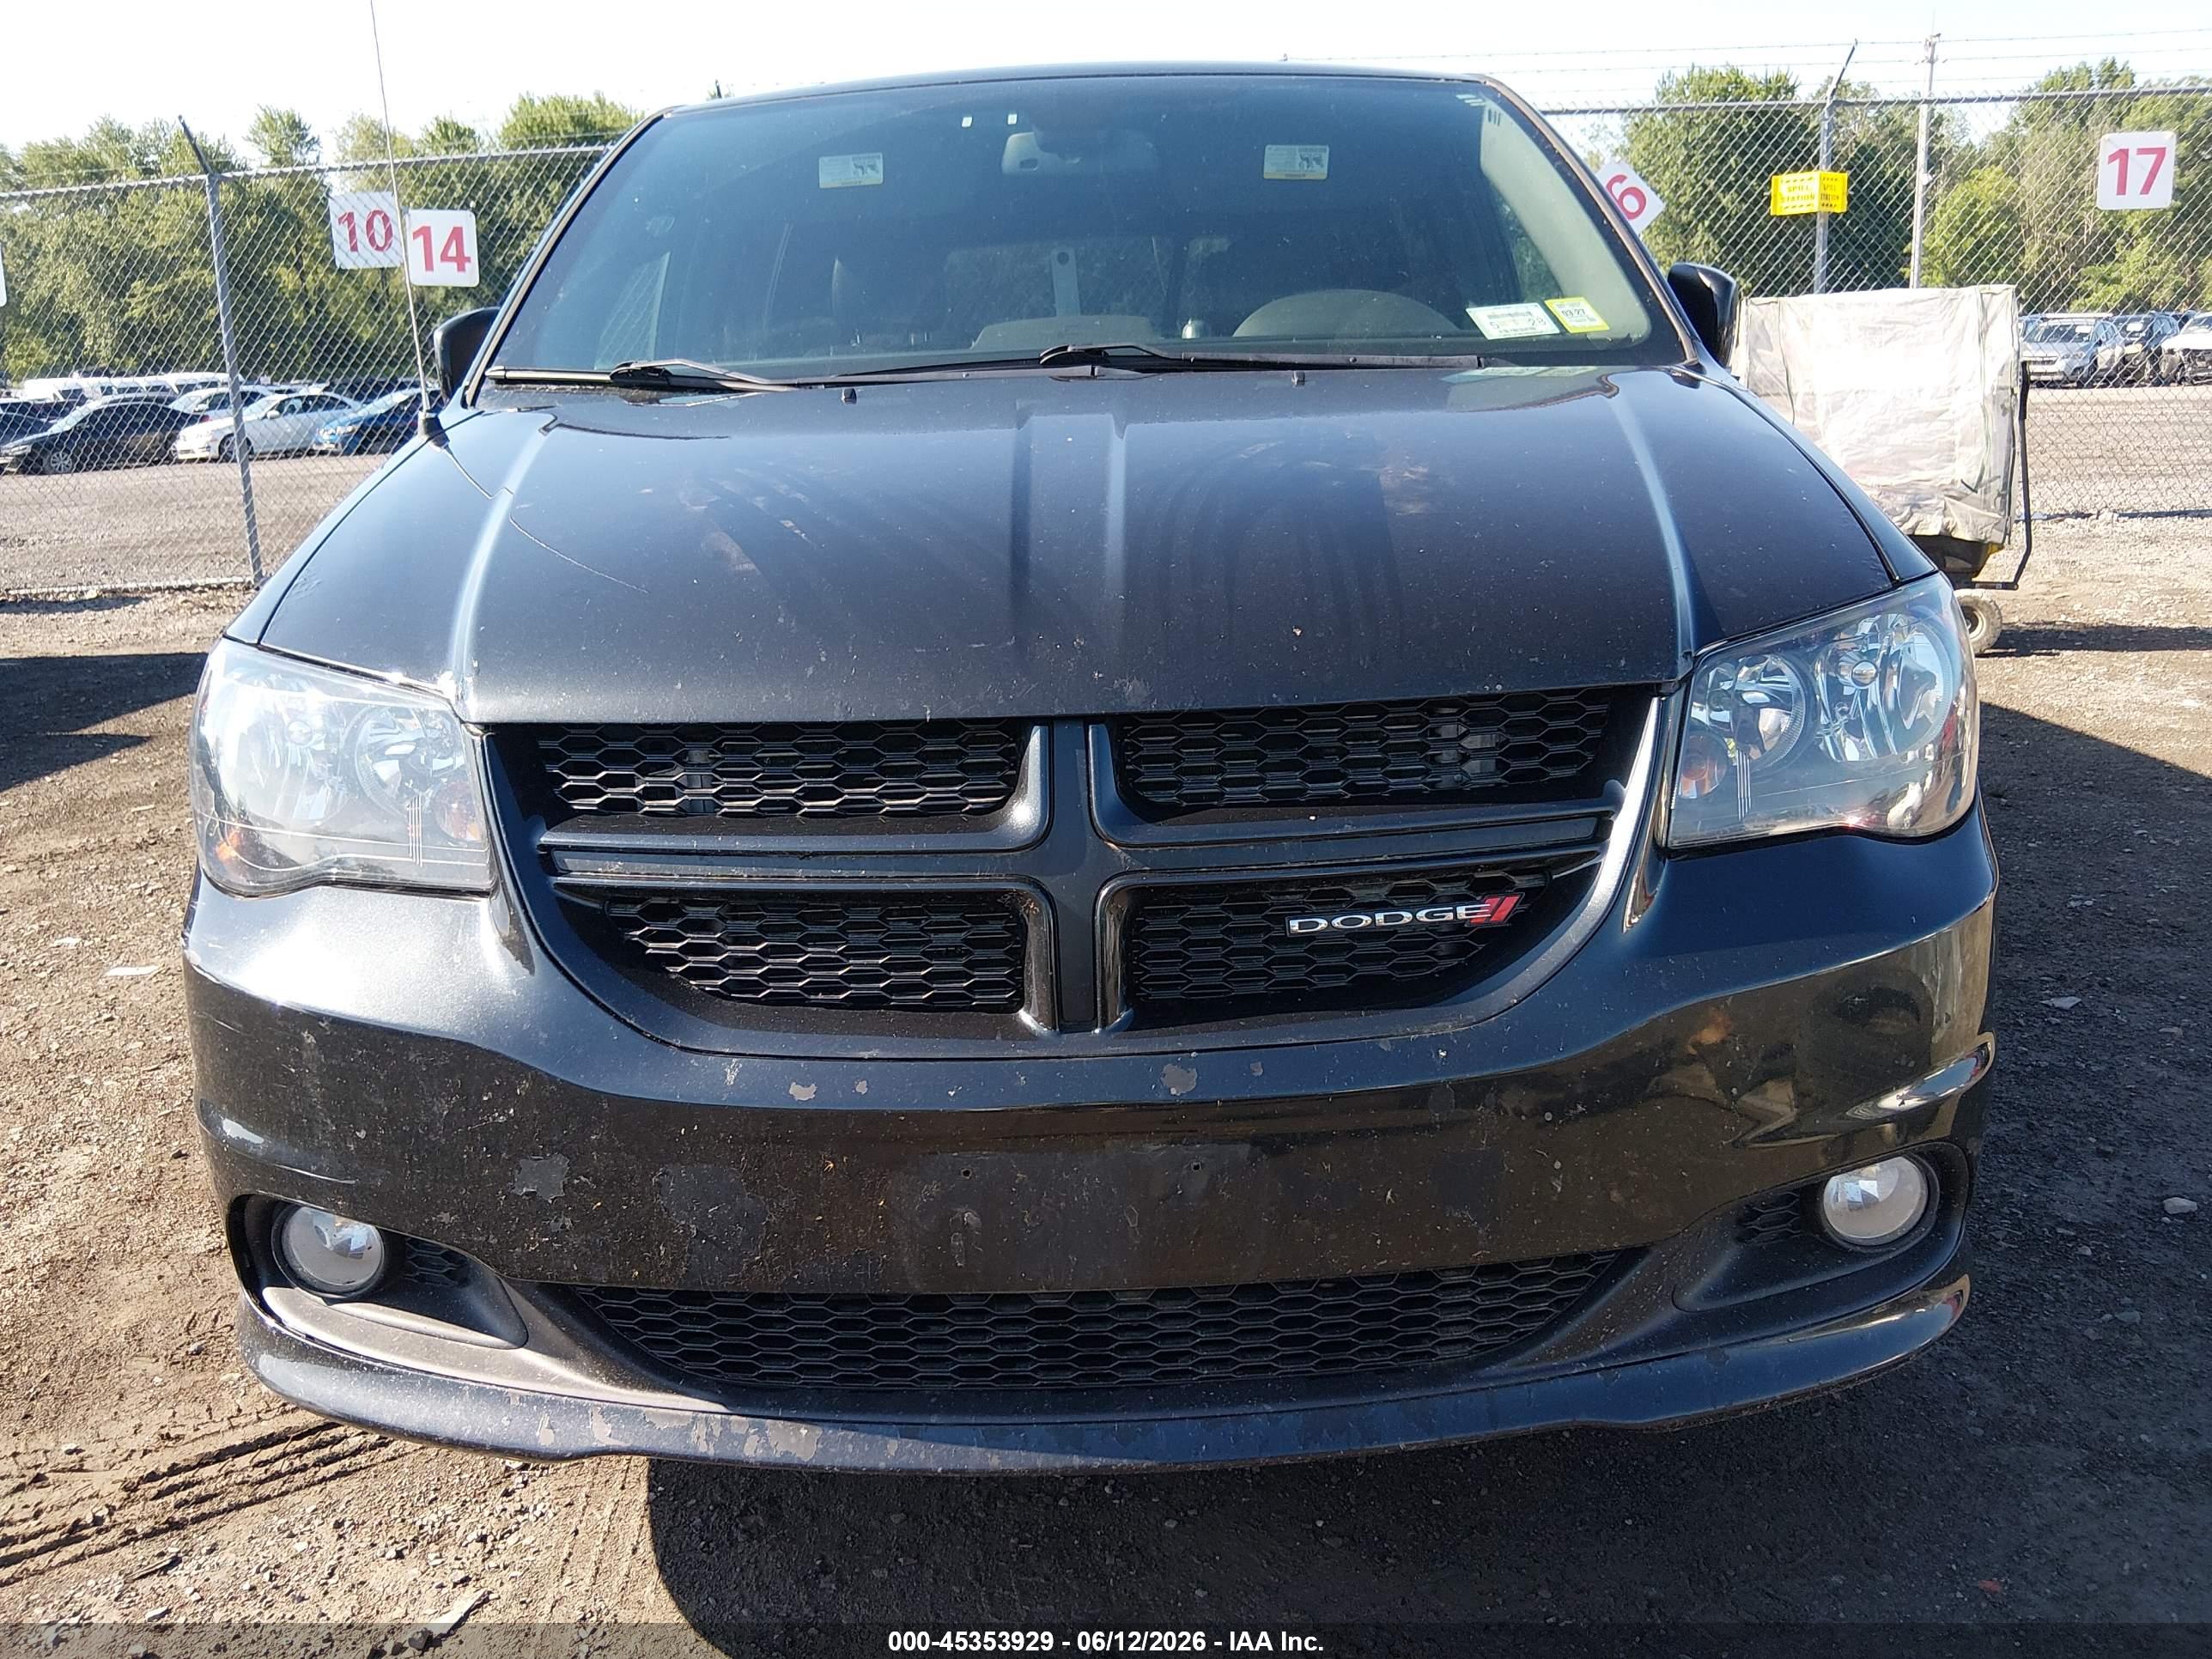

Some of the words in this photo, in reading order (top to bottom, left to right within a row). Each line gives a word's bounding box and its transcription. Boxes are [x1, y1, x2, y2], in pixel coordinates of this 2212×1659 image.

[2107, 147, 2166, 196] 17
[337, 210, 393, 252] 10
[412, 226, 471, 272] 14
[1289, 903, 1492, 933] DODGE
